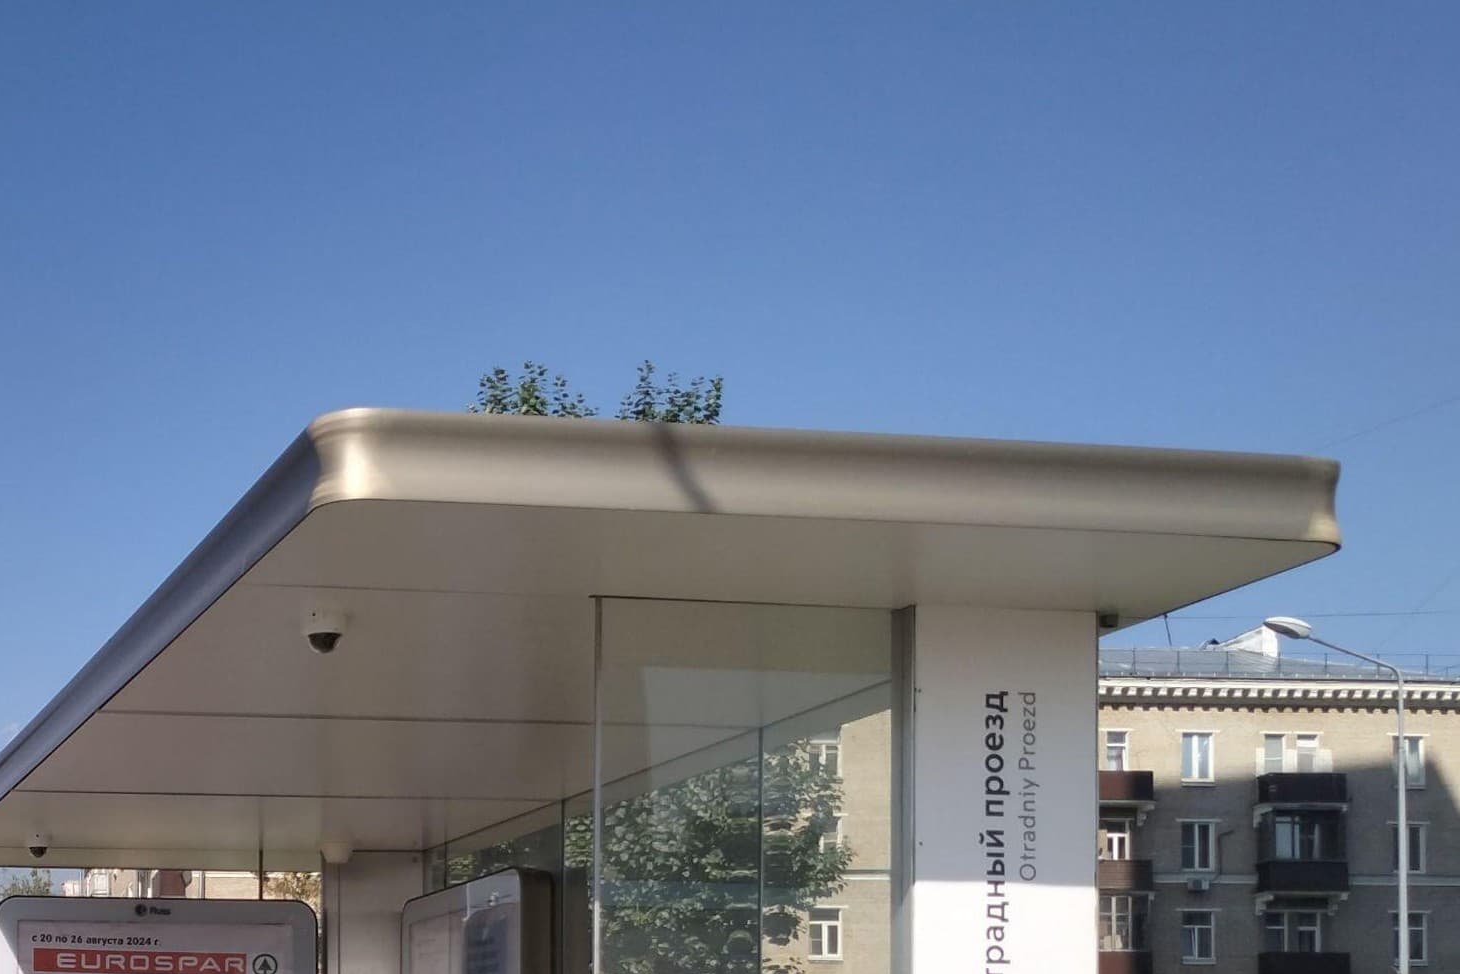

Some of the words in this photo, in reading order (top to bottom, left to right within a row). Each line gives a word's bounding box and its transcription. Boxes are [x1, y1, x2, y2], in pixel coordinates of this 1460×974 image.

[984, 690, 1011, 818] проезд
[1018, 691, 1037, 770] Proezd
[1018, 777, 1040, 881] Otradniy
[40, 934, 52, 943] 20
[55, 935, 68, 943] по
[71, 935, 83, 944] 26
[86, 936, 123, 947] августа
[126, 937, 151, 946] 2024
[56, 952, 246, 973] EUROSPAR
